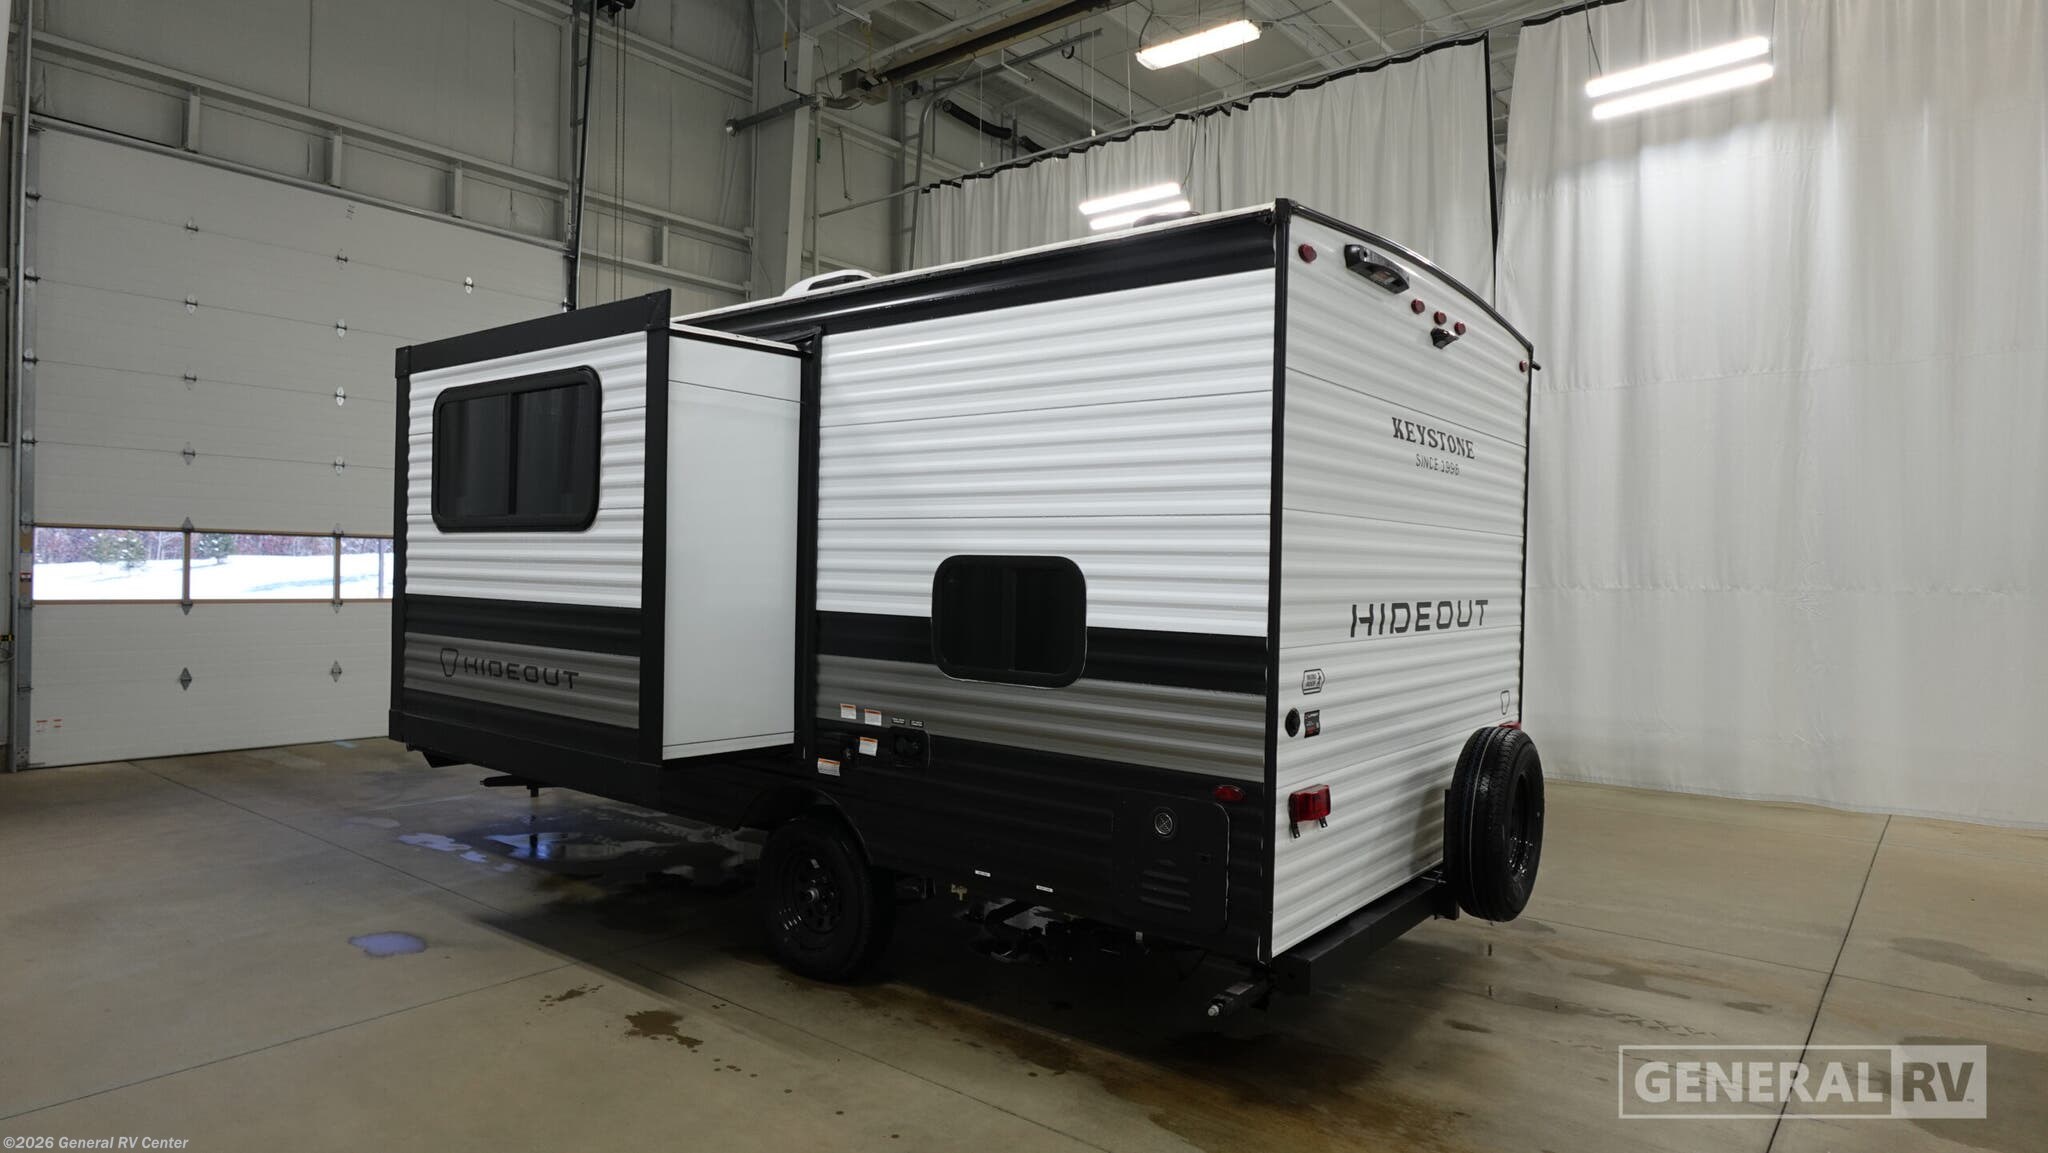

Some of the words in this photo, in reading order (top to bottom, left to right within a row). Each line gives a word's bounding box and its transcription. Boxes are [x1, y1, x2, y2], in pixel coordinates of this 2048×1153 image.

[1391, 416, 1475, 460] KEYSTONE
[1415, 453, 1439, 471] SINCE
[1350, 599, 1488, 638] HIDEOUT
[463, 657, 580, 689] HIDEOUT
